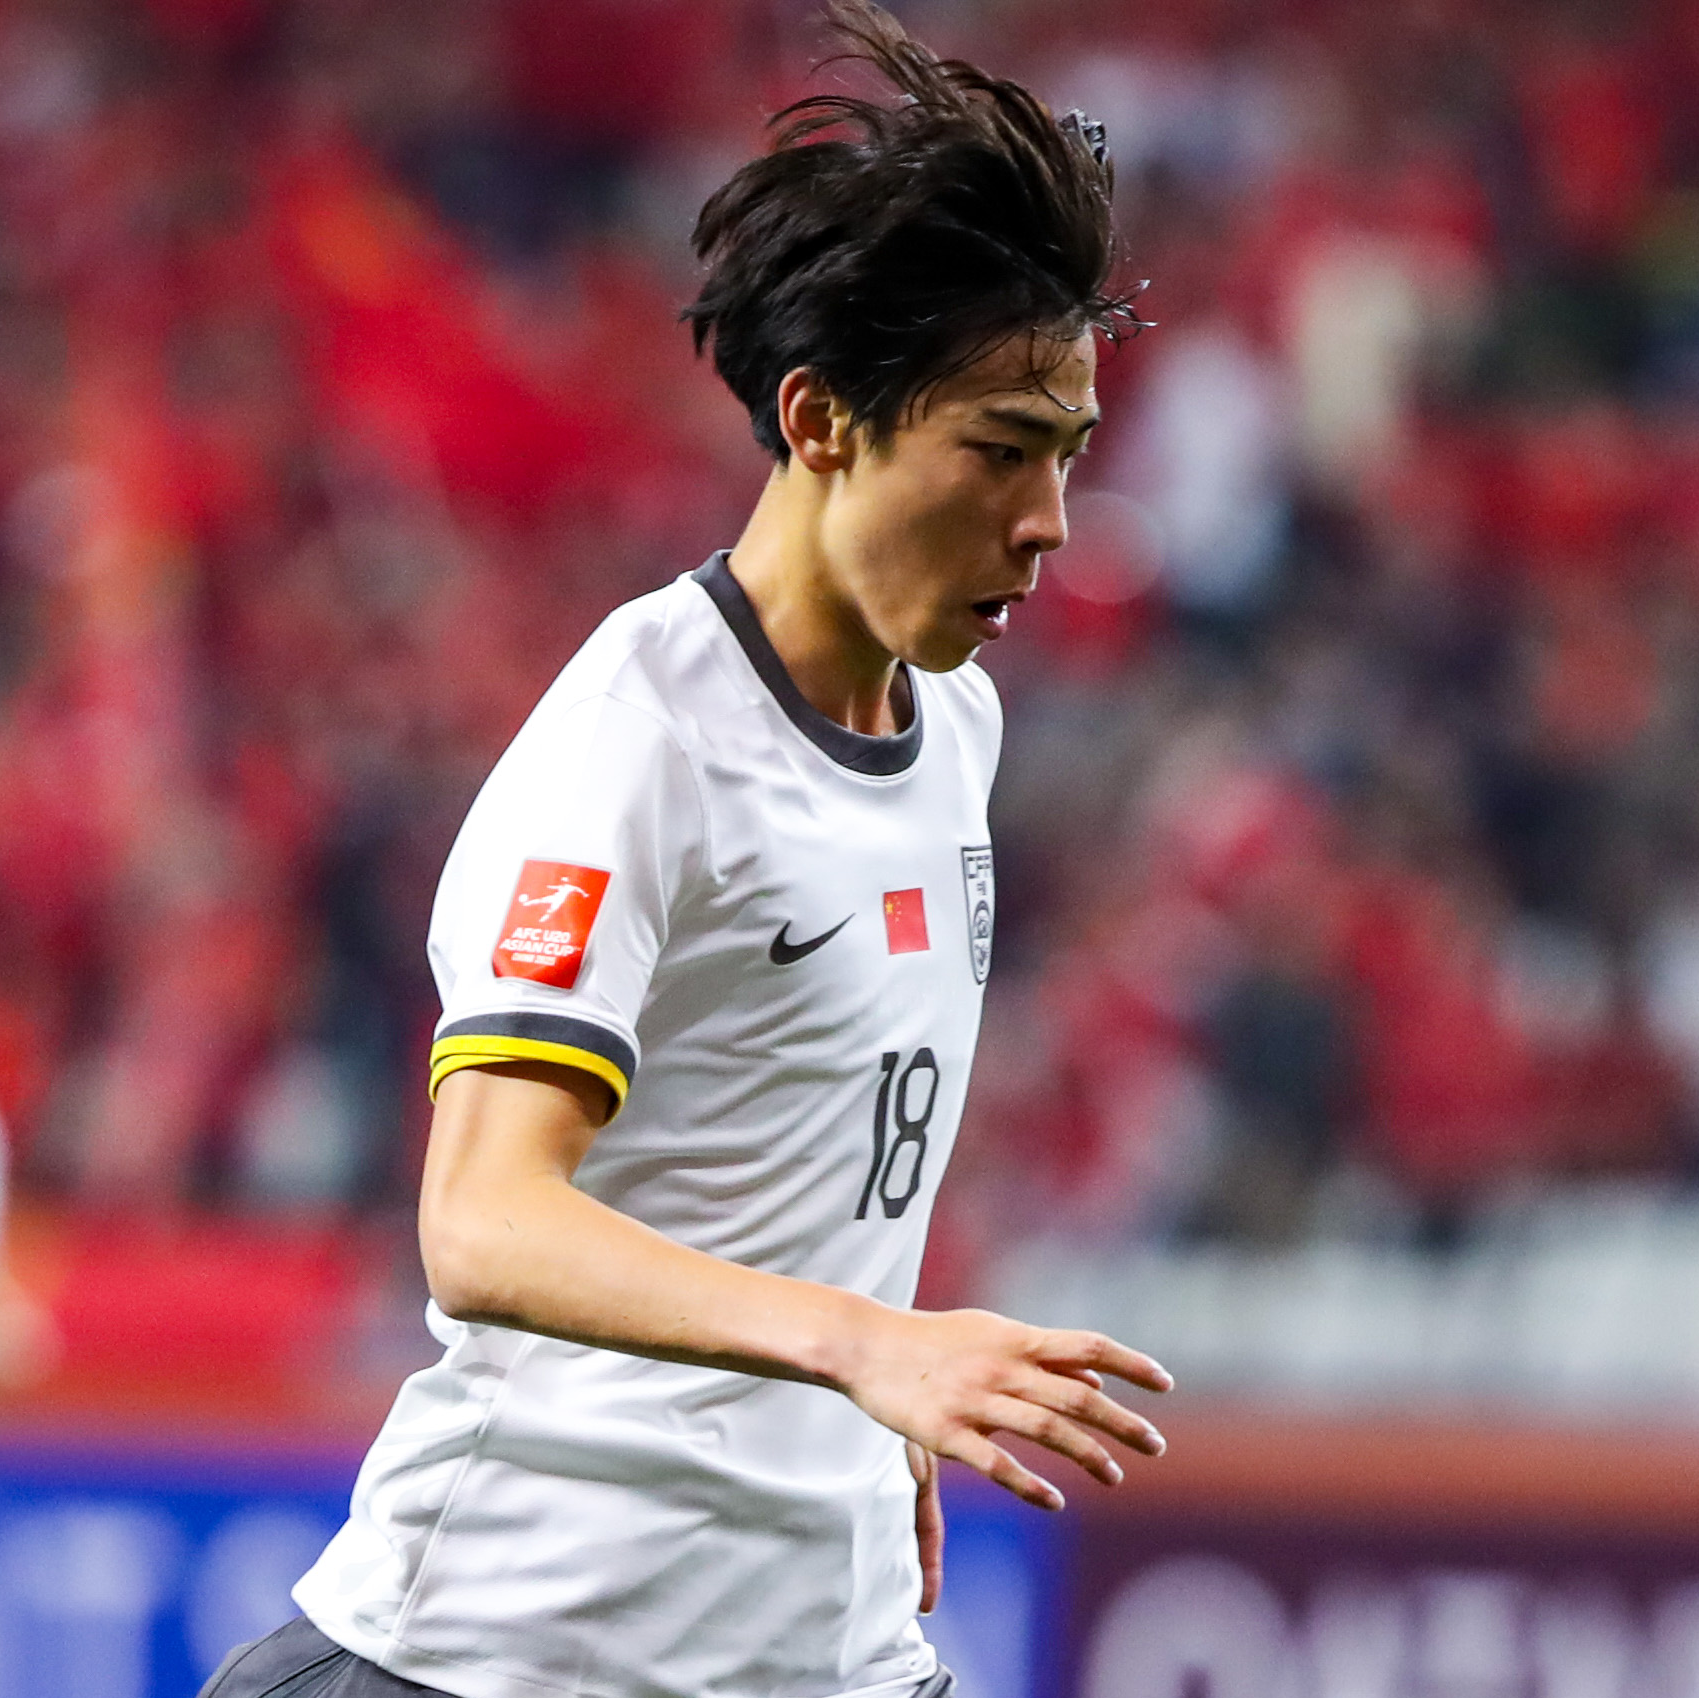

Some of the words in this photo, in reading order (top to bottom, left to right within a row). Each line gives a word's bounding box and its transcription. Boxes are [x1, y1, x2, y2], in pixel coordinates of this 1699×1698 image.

[511, 927, 542, 941] AFC
[542, 929, 571, 944] U20
[499, 938, 544, 953] ASIAN
[543, 942, 575, 957] CUP
[854, 1047, 940, 1219] 18
